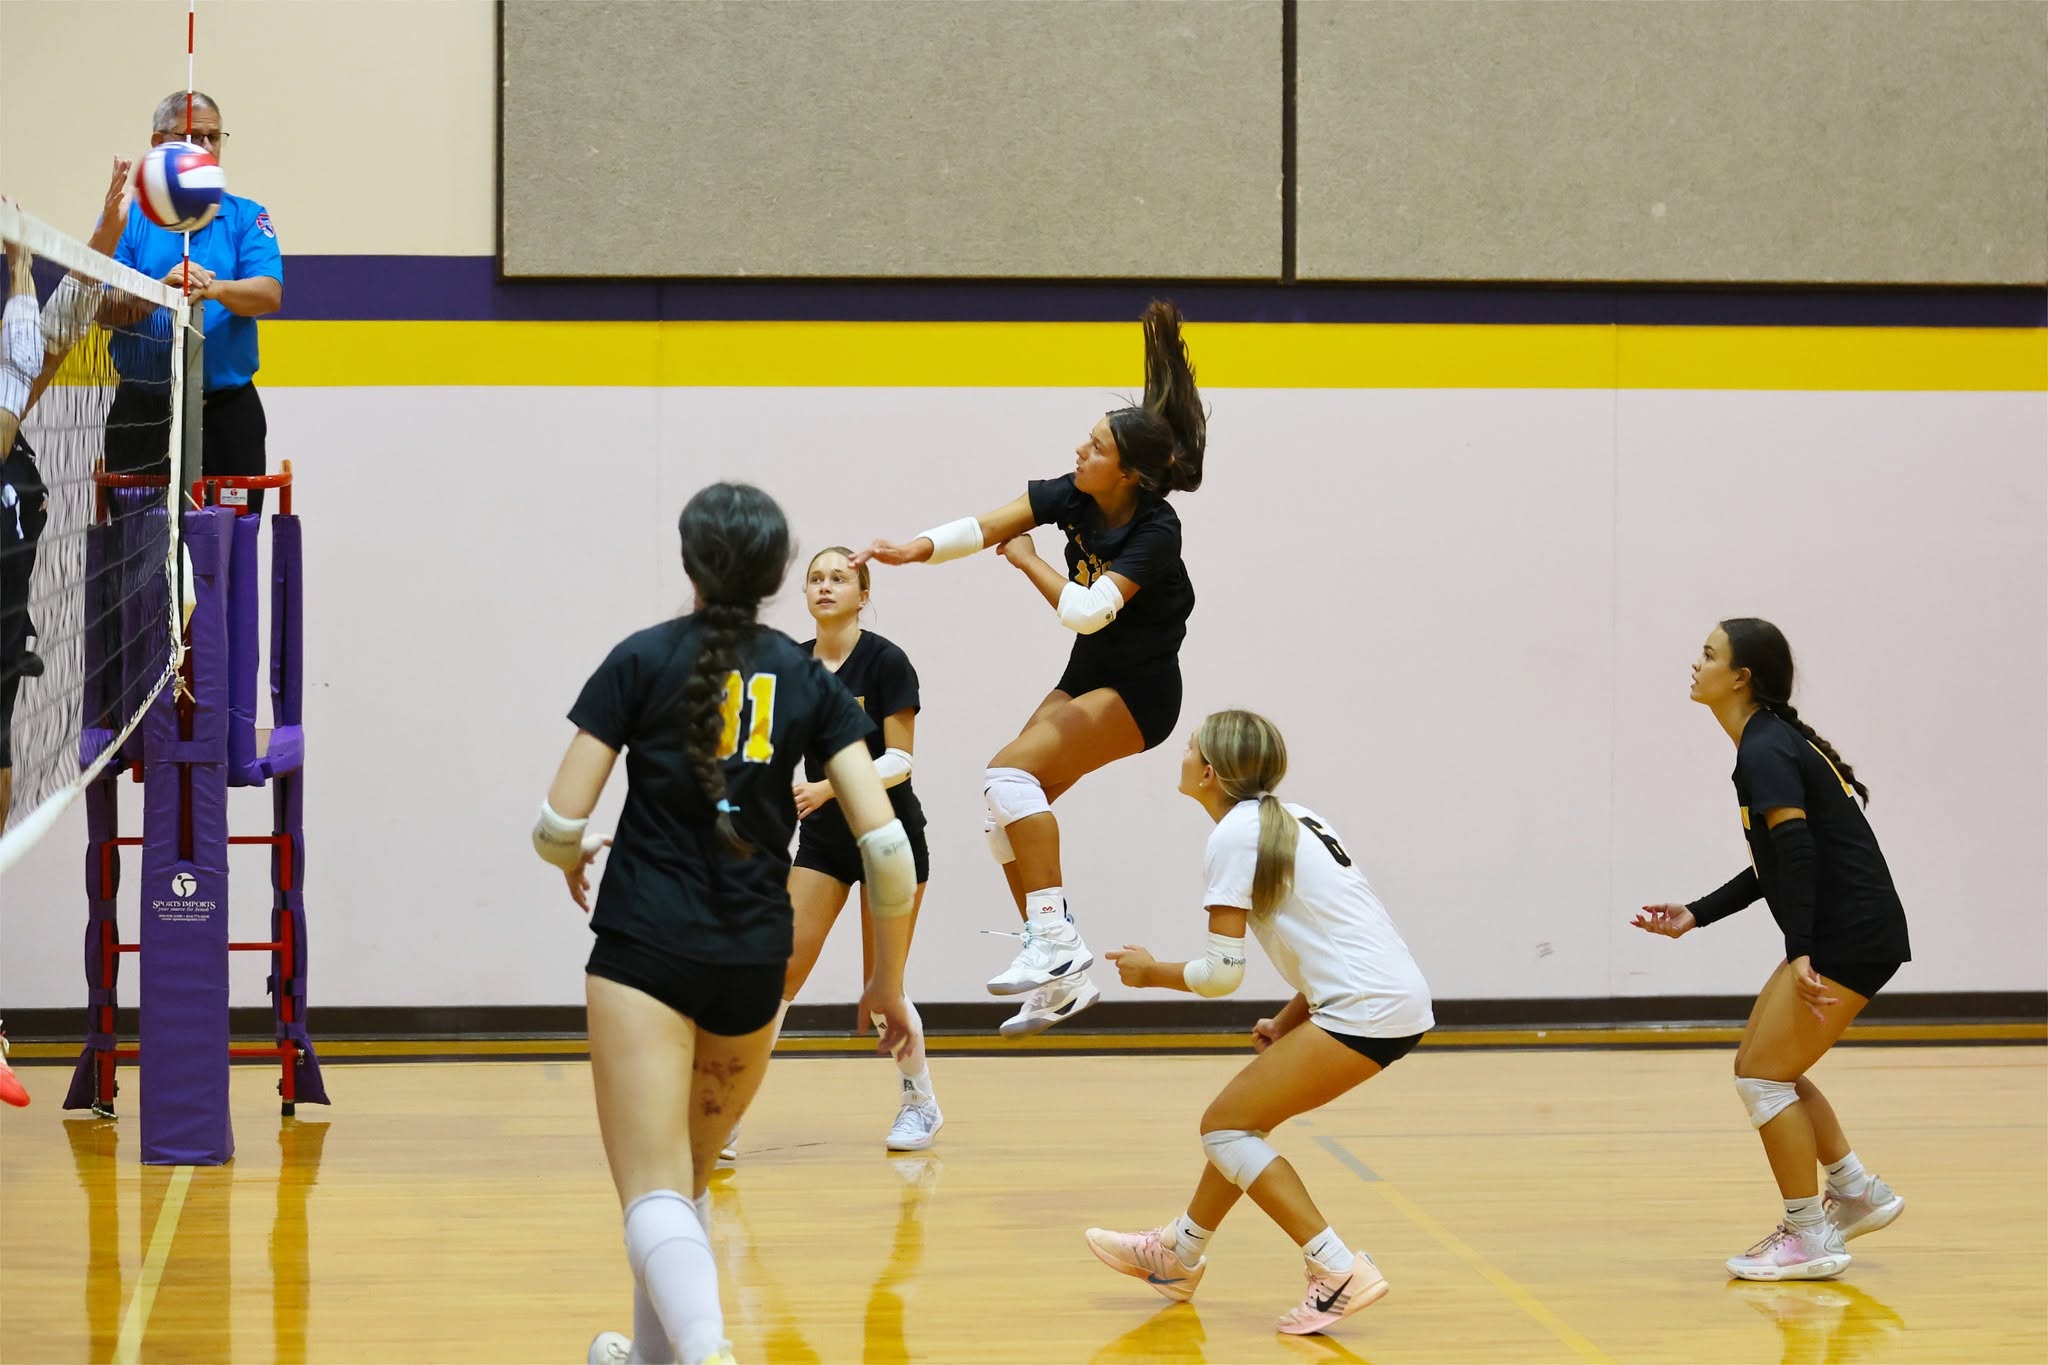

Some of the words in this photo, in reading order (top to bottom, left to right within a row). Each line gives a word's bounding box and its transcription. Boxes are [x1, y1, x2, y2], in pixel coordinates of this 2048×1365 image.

[1297, 816, 1352, 867] 6
[152, 900, 181, 909] SPORTS
[182, 901, 216, 910] IMPORTS
